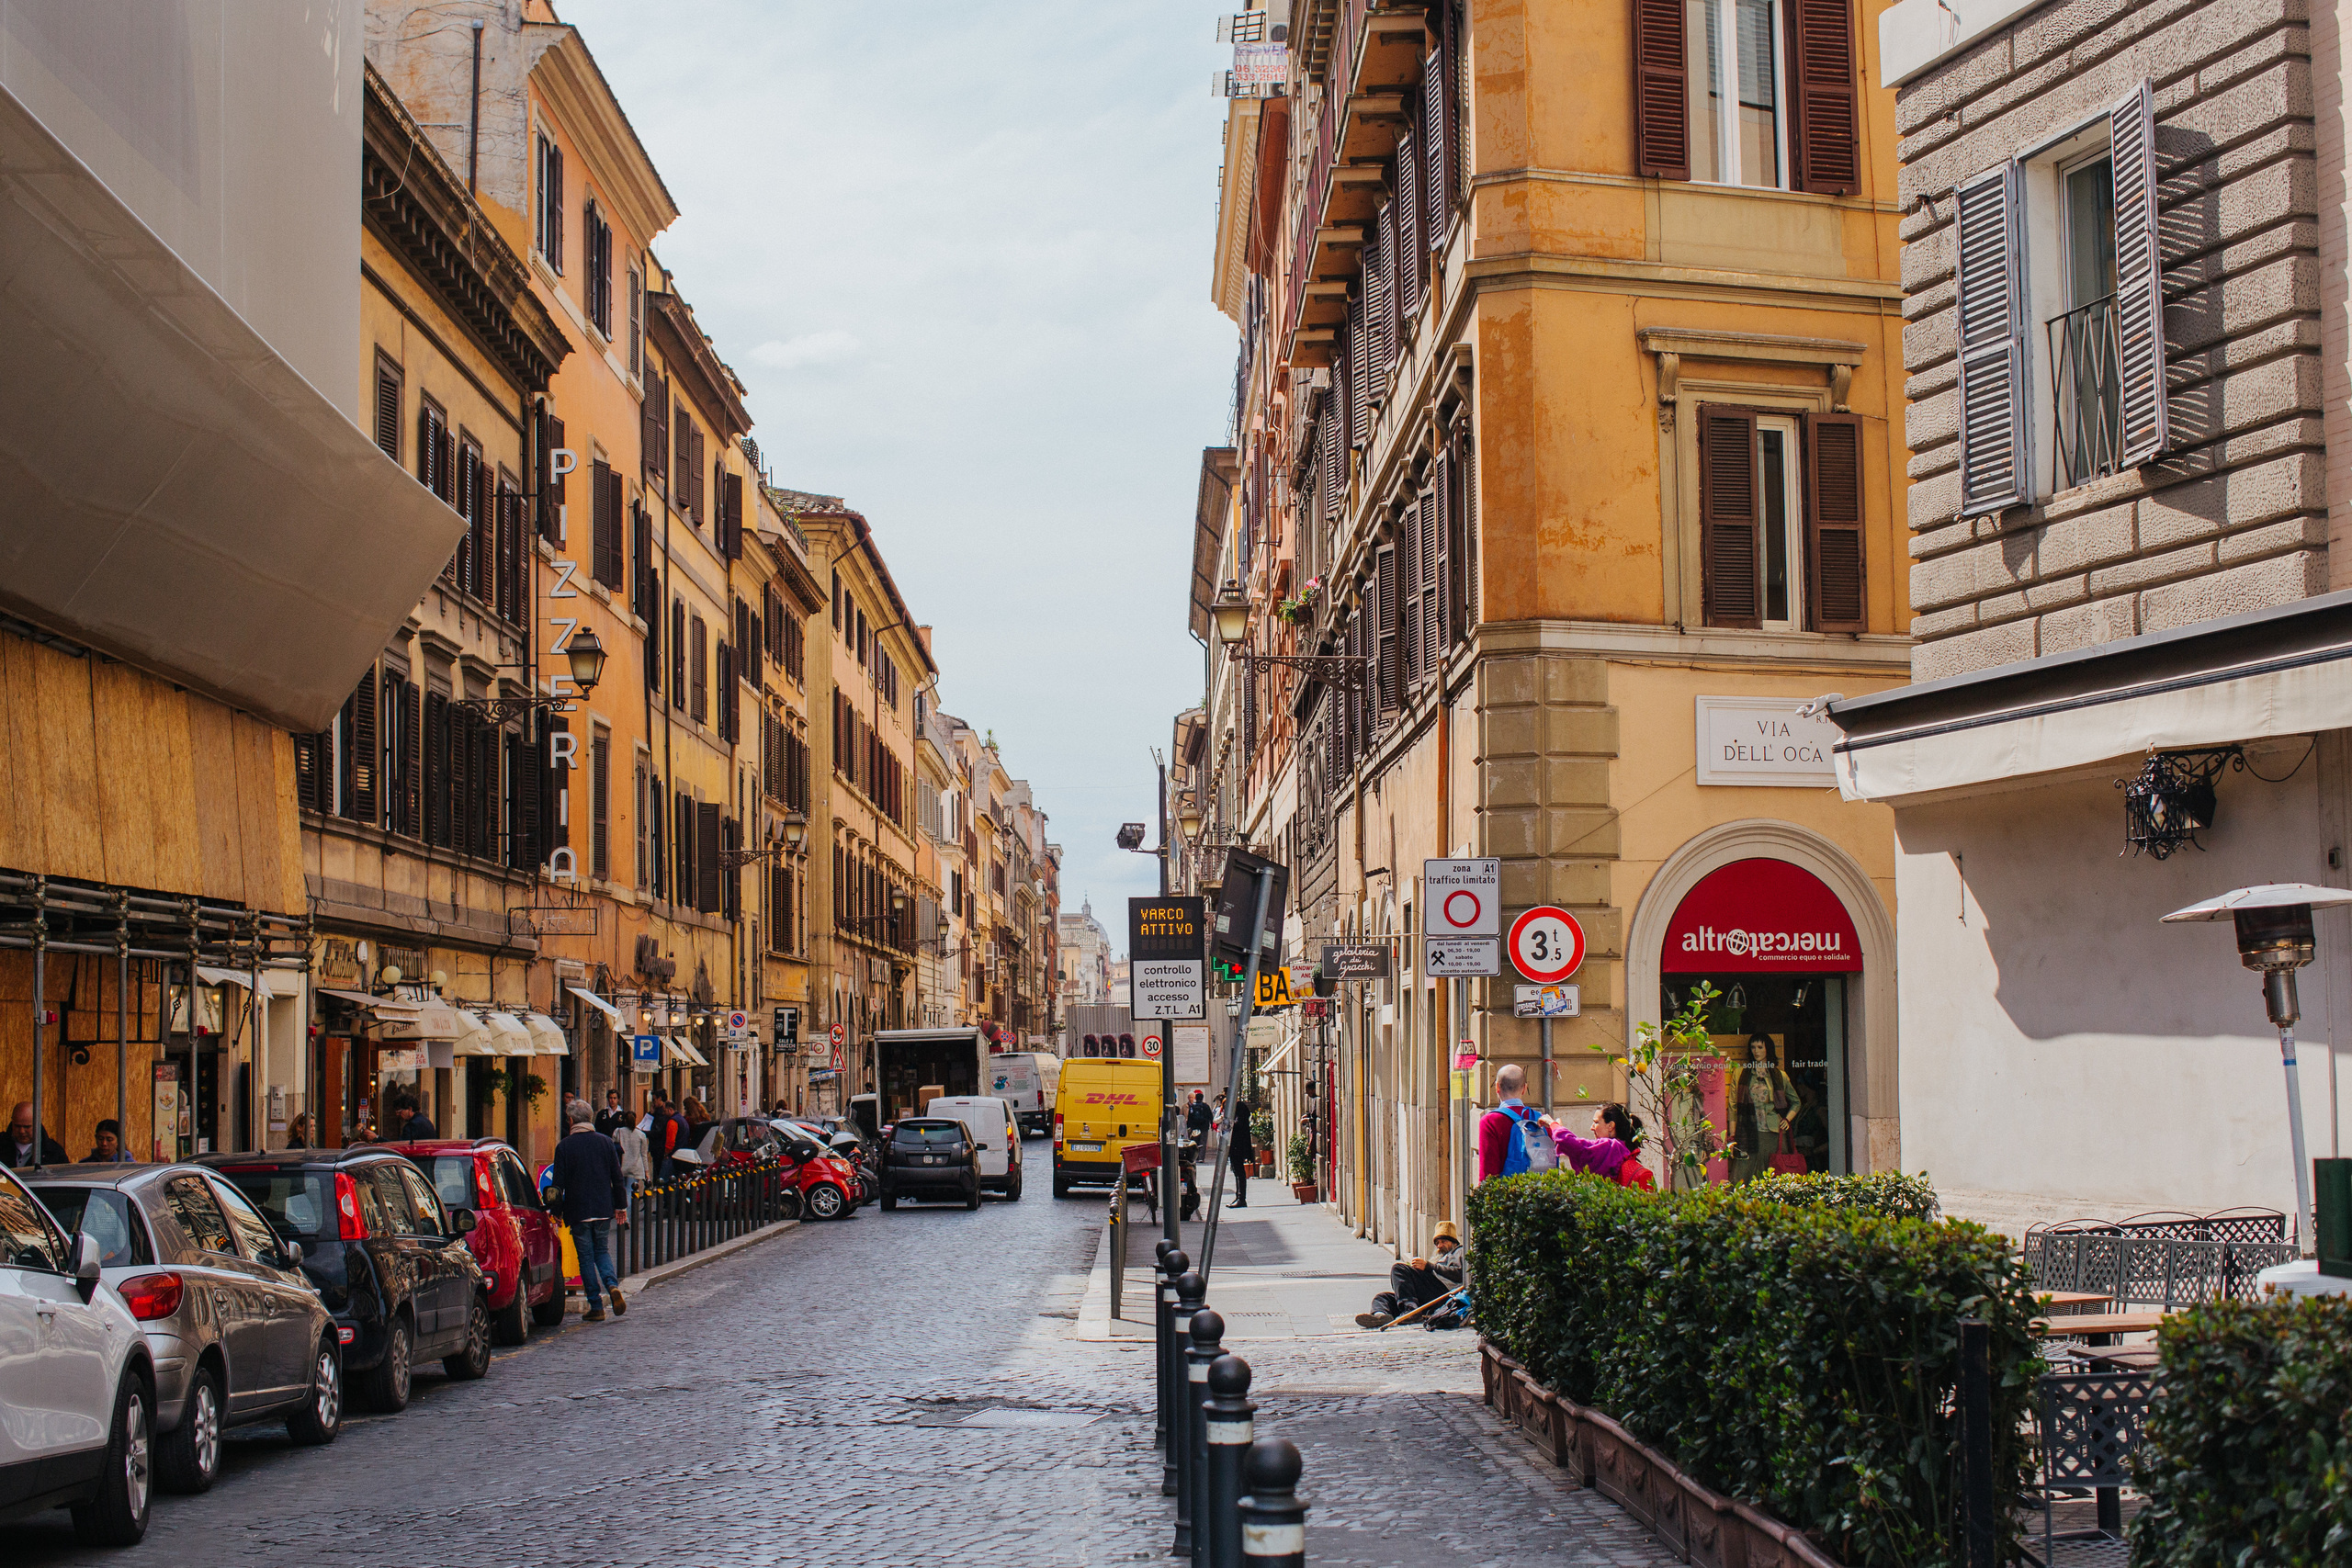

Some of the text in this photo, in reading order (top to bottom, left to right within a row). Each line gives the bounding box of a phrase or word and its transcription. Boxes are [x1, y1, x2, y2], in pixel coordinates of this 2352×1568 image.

[1262, 46, 1288, 56] VEN
[1235, 64, 1250, 73] 06
[549, 448, 578, 885] PIZZERIA
[1757, 721, 1791, 736] VIA
[1783, 746, 1823, 762] OCA
[1484, 864, 1495, 874] A1
[1429, 875, 1496, 884] traffico limitato
[1140, 908, 1183, 919] VARCO
[1140, 923, 1193, 935] ATTIVO
[1553, 929, 1558, 942] t
[1531, 931, 1548, 961] 3
[1332, 943, 1379, 964] gelateria
[1144, 965, 1192, 975] controllo
[1338, 960, 1376, 979] Gracchi
[1139, 978, 1196, 987] elettronico
[1260, 970, 1290, 1002] BA
[1148, 993, 1189, 1001] accesso
[1155, 1004, 1201, 1015] Z.T.L. A1
[776, 1009, 796, 1036] T
[640, 1040, 653, 1055] P
[1147, 1041, 1159, 1052] 30
[1742, 1061, 1775, 1069] solidale
[1792, 1059, 1828, 1068] fair trade
[1085, 1092, 1140, 1106] DHL
